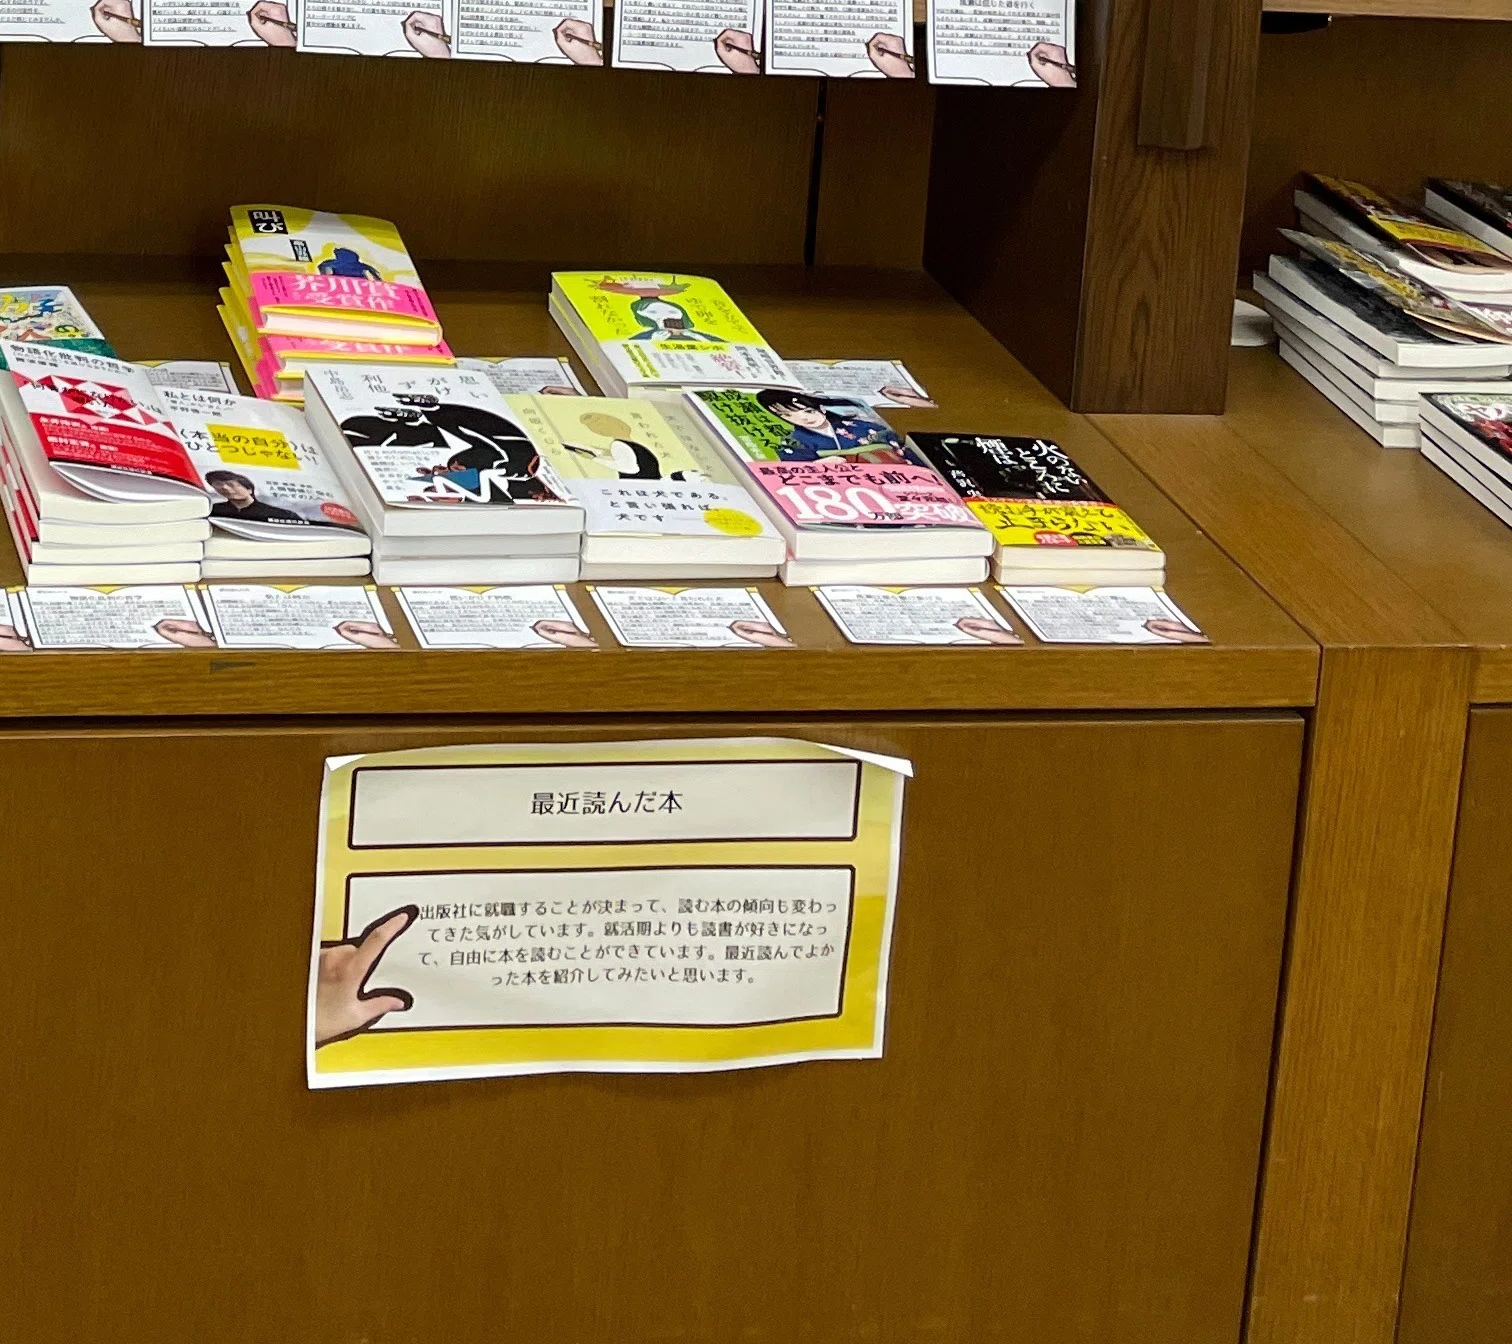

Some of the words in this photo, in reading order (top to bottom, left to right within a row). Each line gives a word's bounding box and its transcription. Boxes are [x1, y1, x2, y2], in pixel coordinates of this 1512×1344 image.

[775, 485, 892, 522] 180
[530, 789, 684, 817] 最近読んだ本
